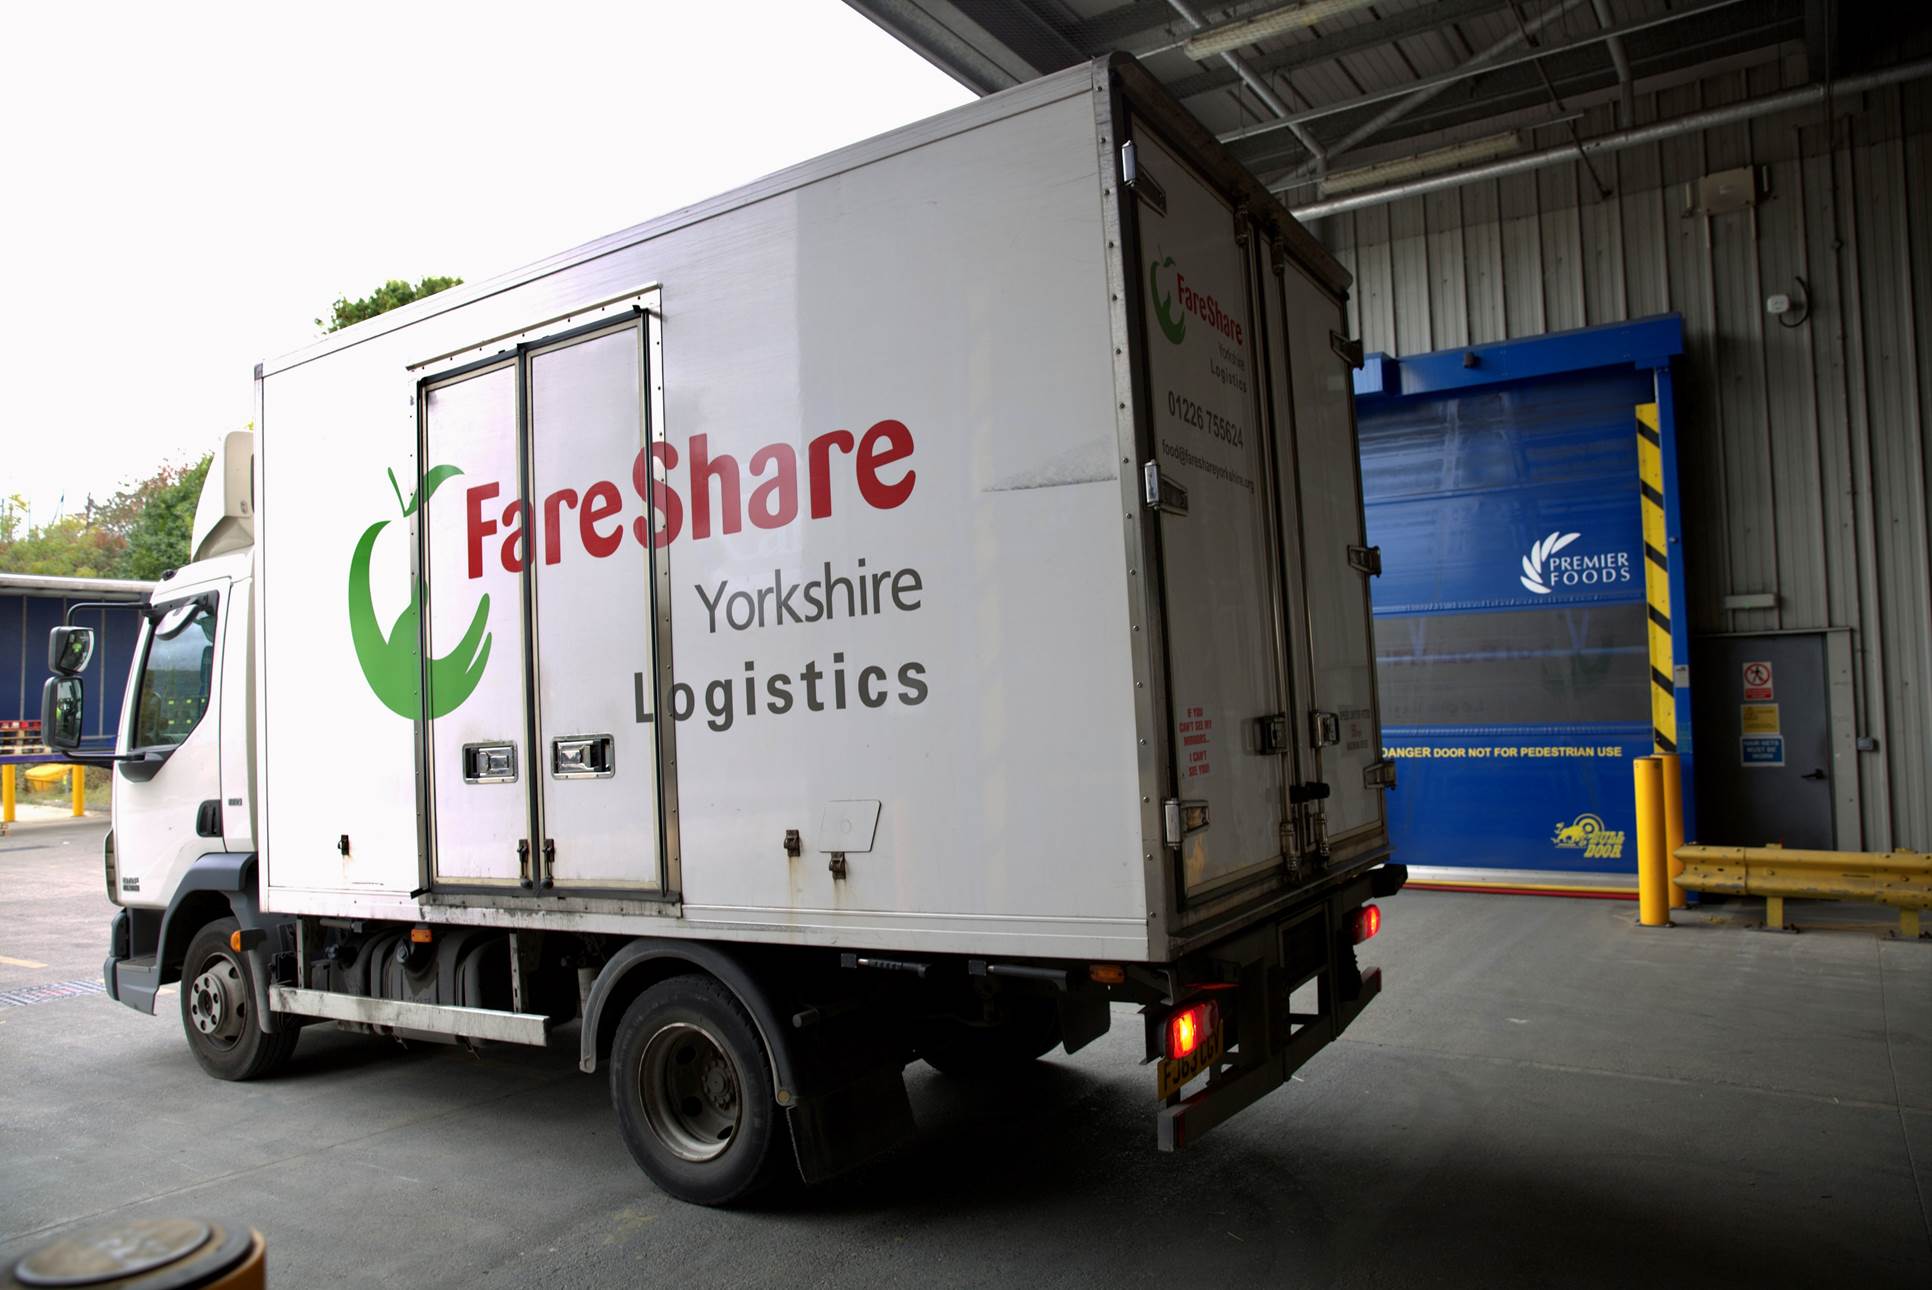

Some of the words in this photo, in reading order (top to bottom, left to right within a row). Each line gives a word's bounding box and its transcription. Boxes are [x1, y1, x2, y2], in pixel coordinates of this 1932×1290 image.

[1176, 272, 1243, 345] FareShare
[1210, 358, 1247, 393] Logistics
[1168, 391, 1204, 434] 01226
[1206, 410, 1244, 449] 755624
[466, 419, 916, 579] FareShare
[1550, 552, 1629, 571] PREMIER
[1551, 567, 1631, 587] FOODS
[694, 557, 923, 634] Yorkshire
[634, 651, 929, 732] Logistics
[1433, 747, 1466, 758] DOOR
[1468, 747, 1492, 758] NOT
[1494, 747, 1518, 757] FOR
[1520, 746, 1595, 757] PEDESTRIAN
[1597, 746, 1622, 757] USE
[1583, 844, 1622, 858] DOOR
